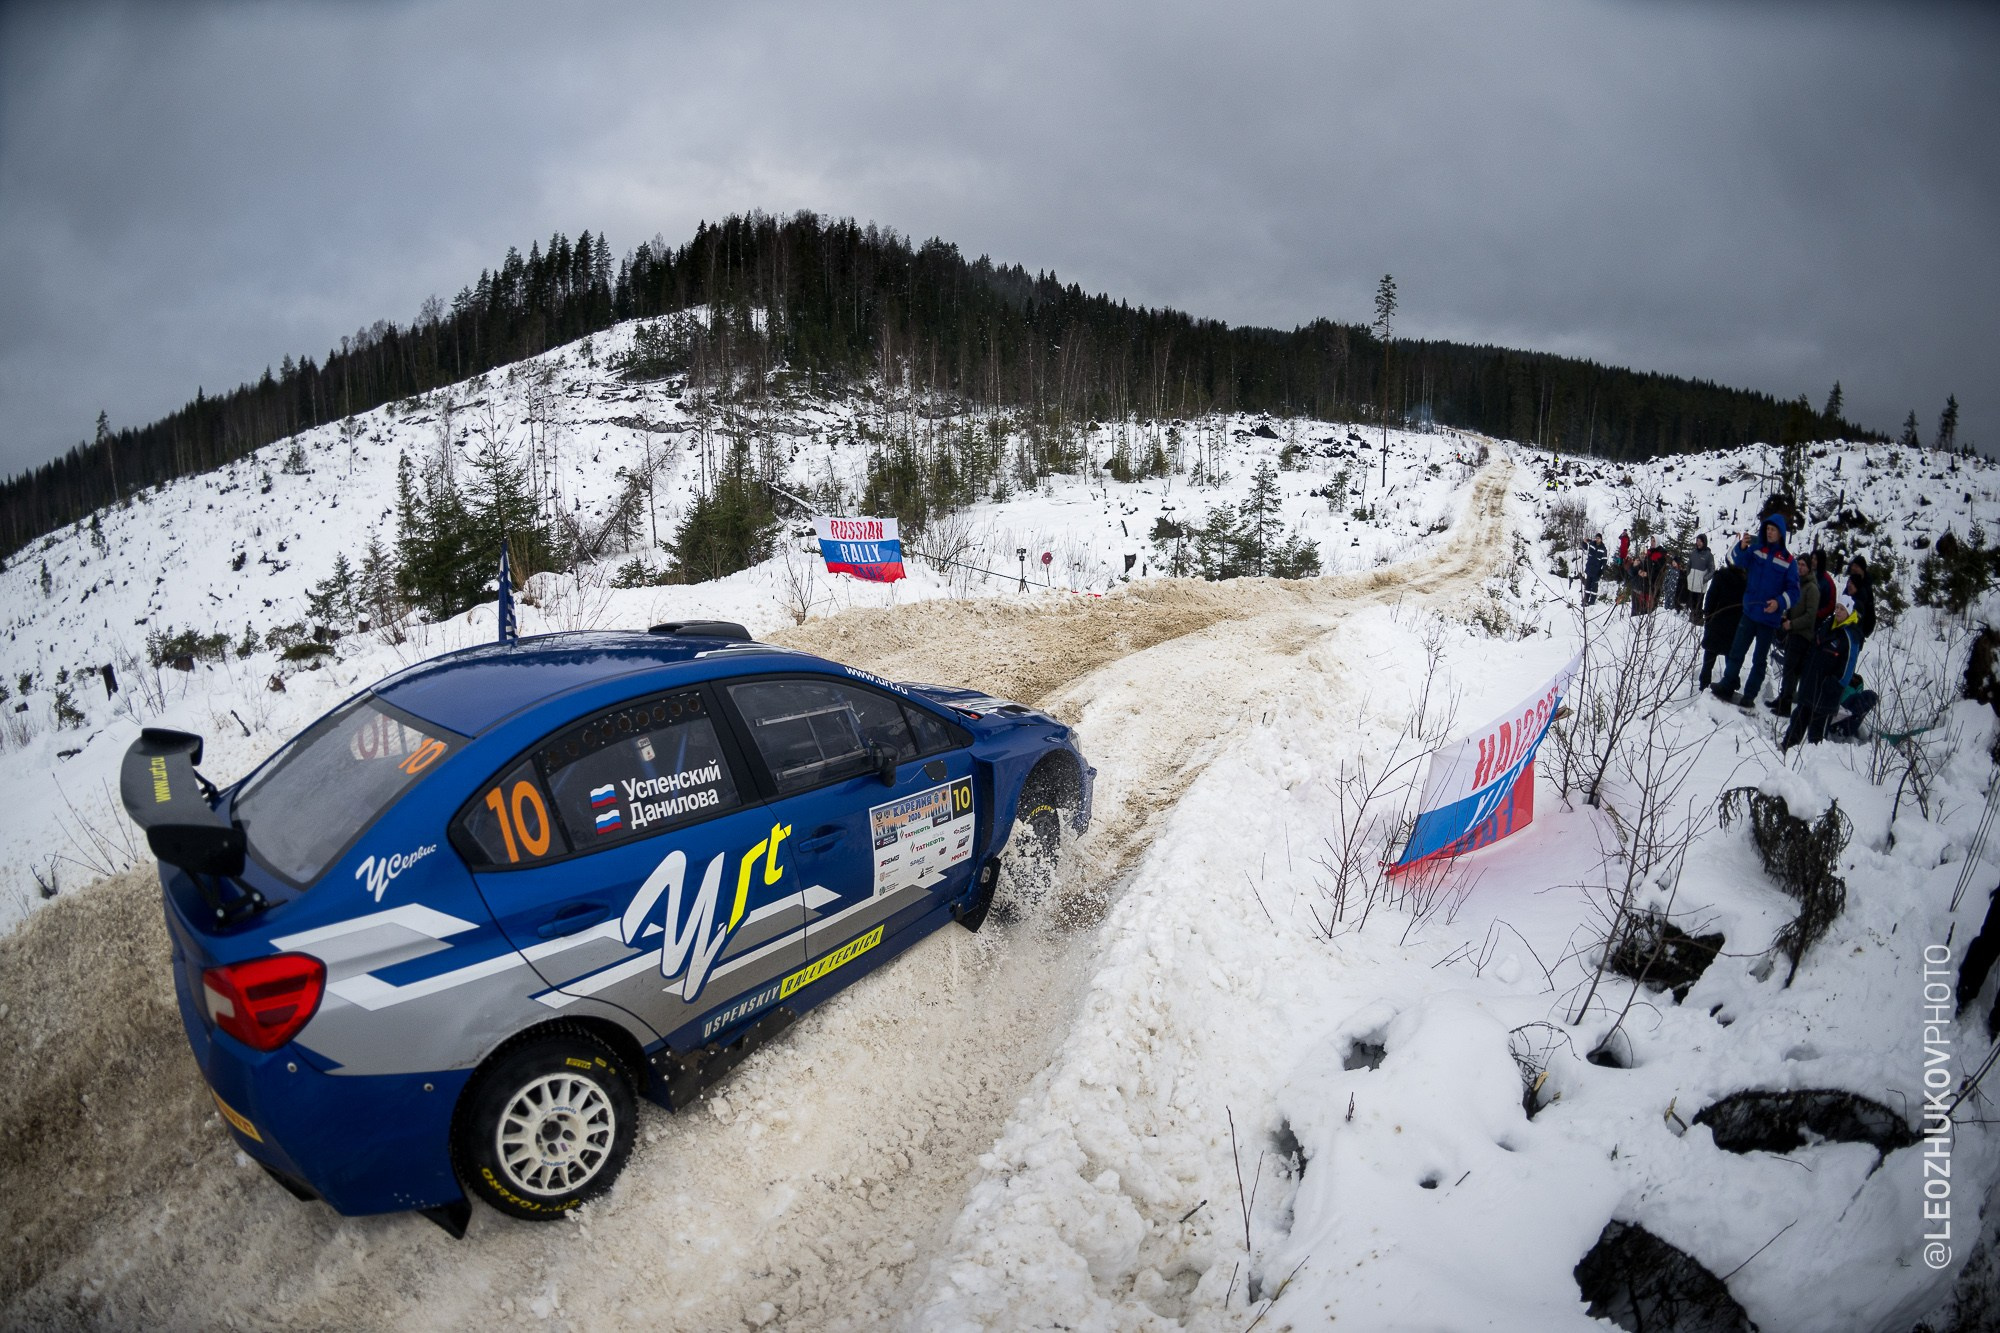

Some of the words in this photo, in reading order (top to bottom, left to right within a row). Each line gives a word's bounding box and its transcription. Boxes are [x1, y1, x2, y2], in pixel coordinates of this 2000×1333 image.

[830, 520, 884, 540] RUSSIAN
[840, 543, 881, 563] RALLY
[845, 666, 909, 696] www.urt.ru
[398, 738, 447, 774] 10
[149, 756, 171, 803] www.urt.ru
[621, 759, 722, 802] Успенский
[630, 789, 719, 830] Данилова
[893, 795, 932, 817] КАРЕЛИЯ
[953, 786, 971, 811] 10
[485, 780, 551, 863] 10
[904, 825, 931, 839] ТАТНЕФТЬ
[915, 837, 945, 852] ТАТНЕФТЬ
[704, 985, 781, 1038] USPENSKIY
[784, 965, 826, 993] RALLY
[828, 930, 879, 968] TECNICA
